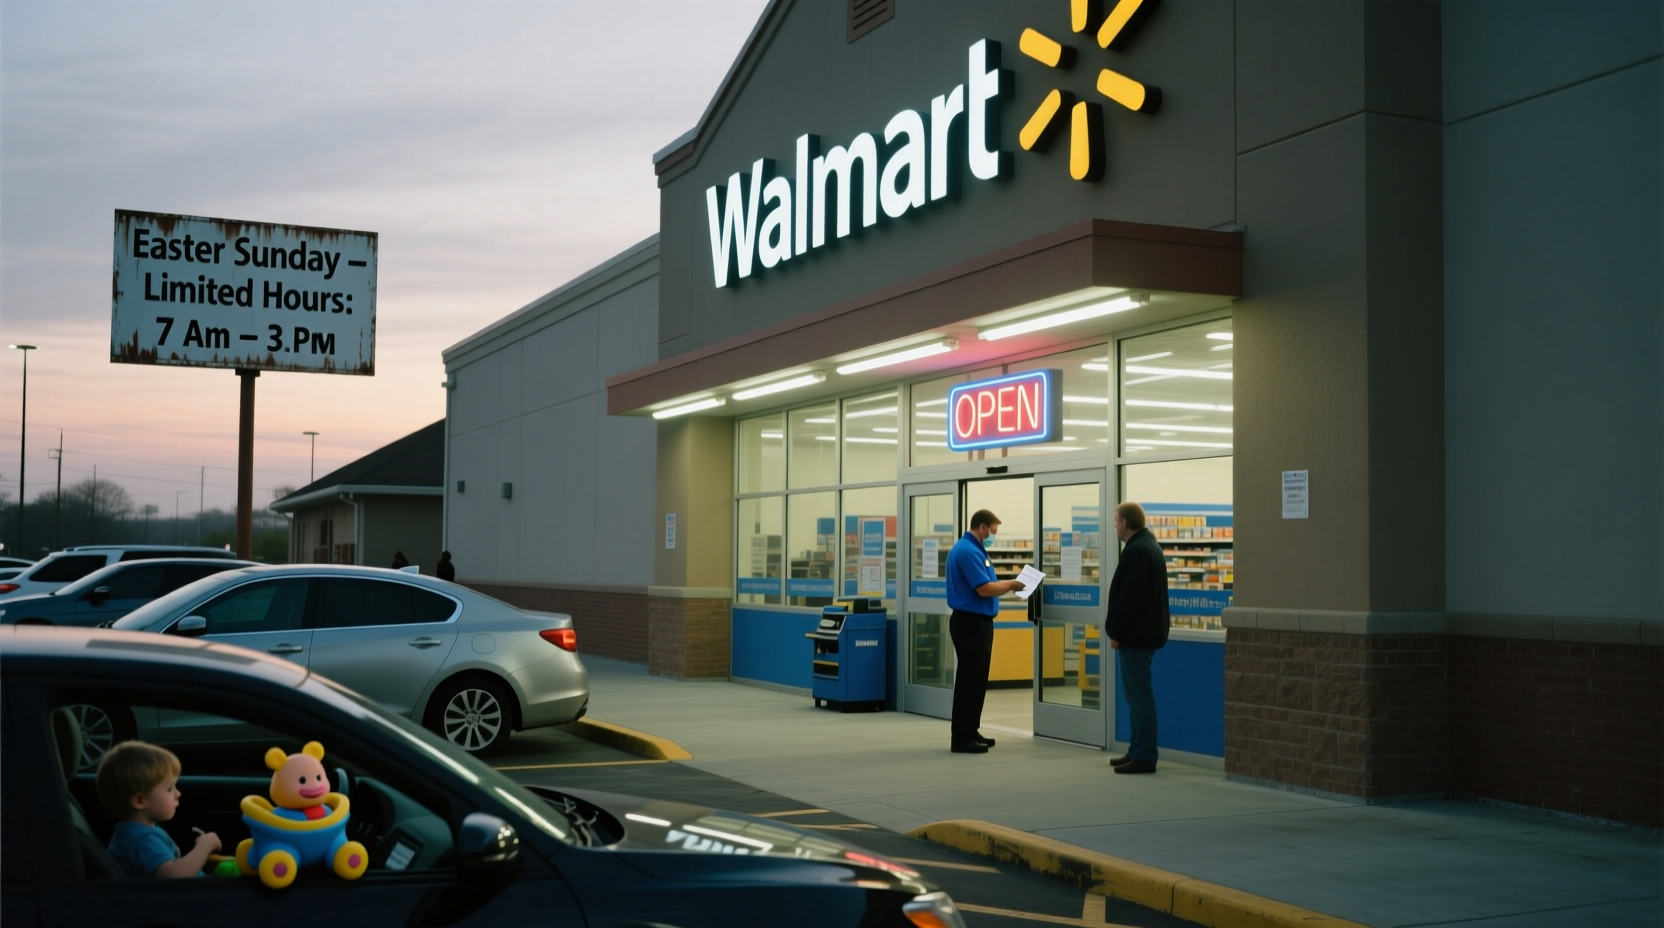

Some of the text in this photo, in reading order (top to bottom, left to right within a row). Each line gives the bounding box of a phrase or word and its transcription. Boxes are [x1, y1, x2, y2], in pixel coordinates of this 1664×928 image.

[706, 38, 999, 288] Walmart
[133, 229, 225, 264] Easter
[234, 237, 341, 280] Sunday
[144, 272, 353, 315] Limited Hours:
[156, 317, 174, 346] 7
[183, 319, 230, 349] Am
[955, 382, 1039, 438] OPEN
